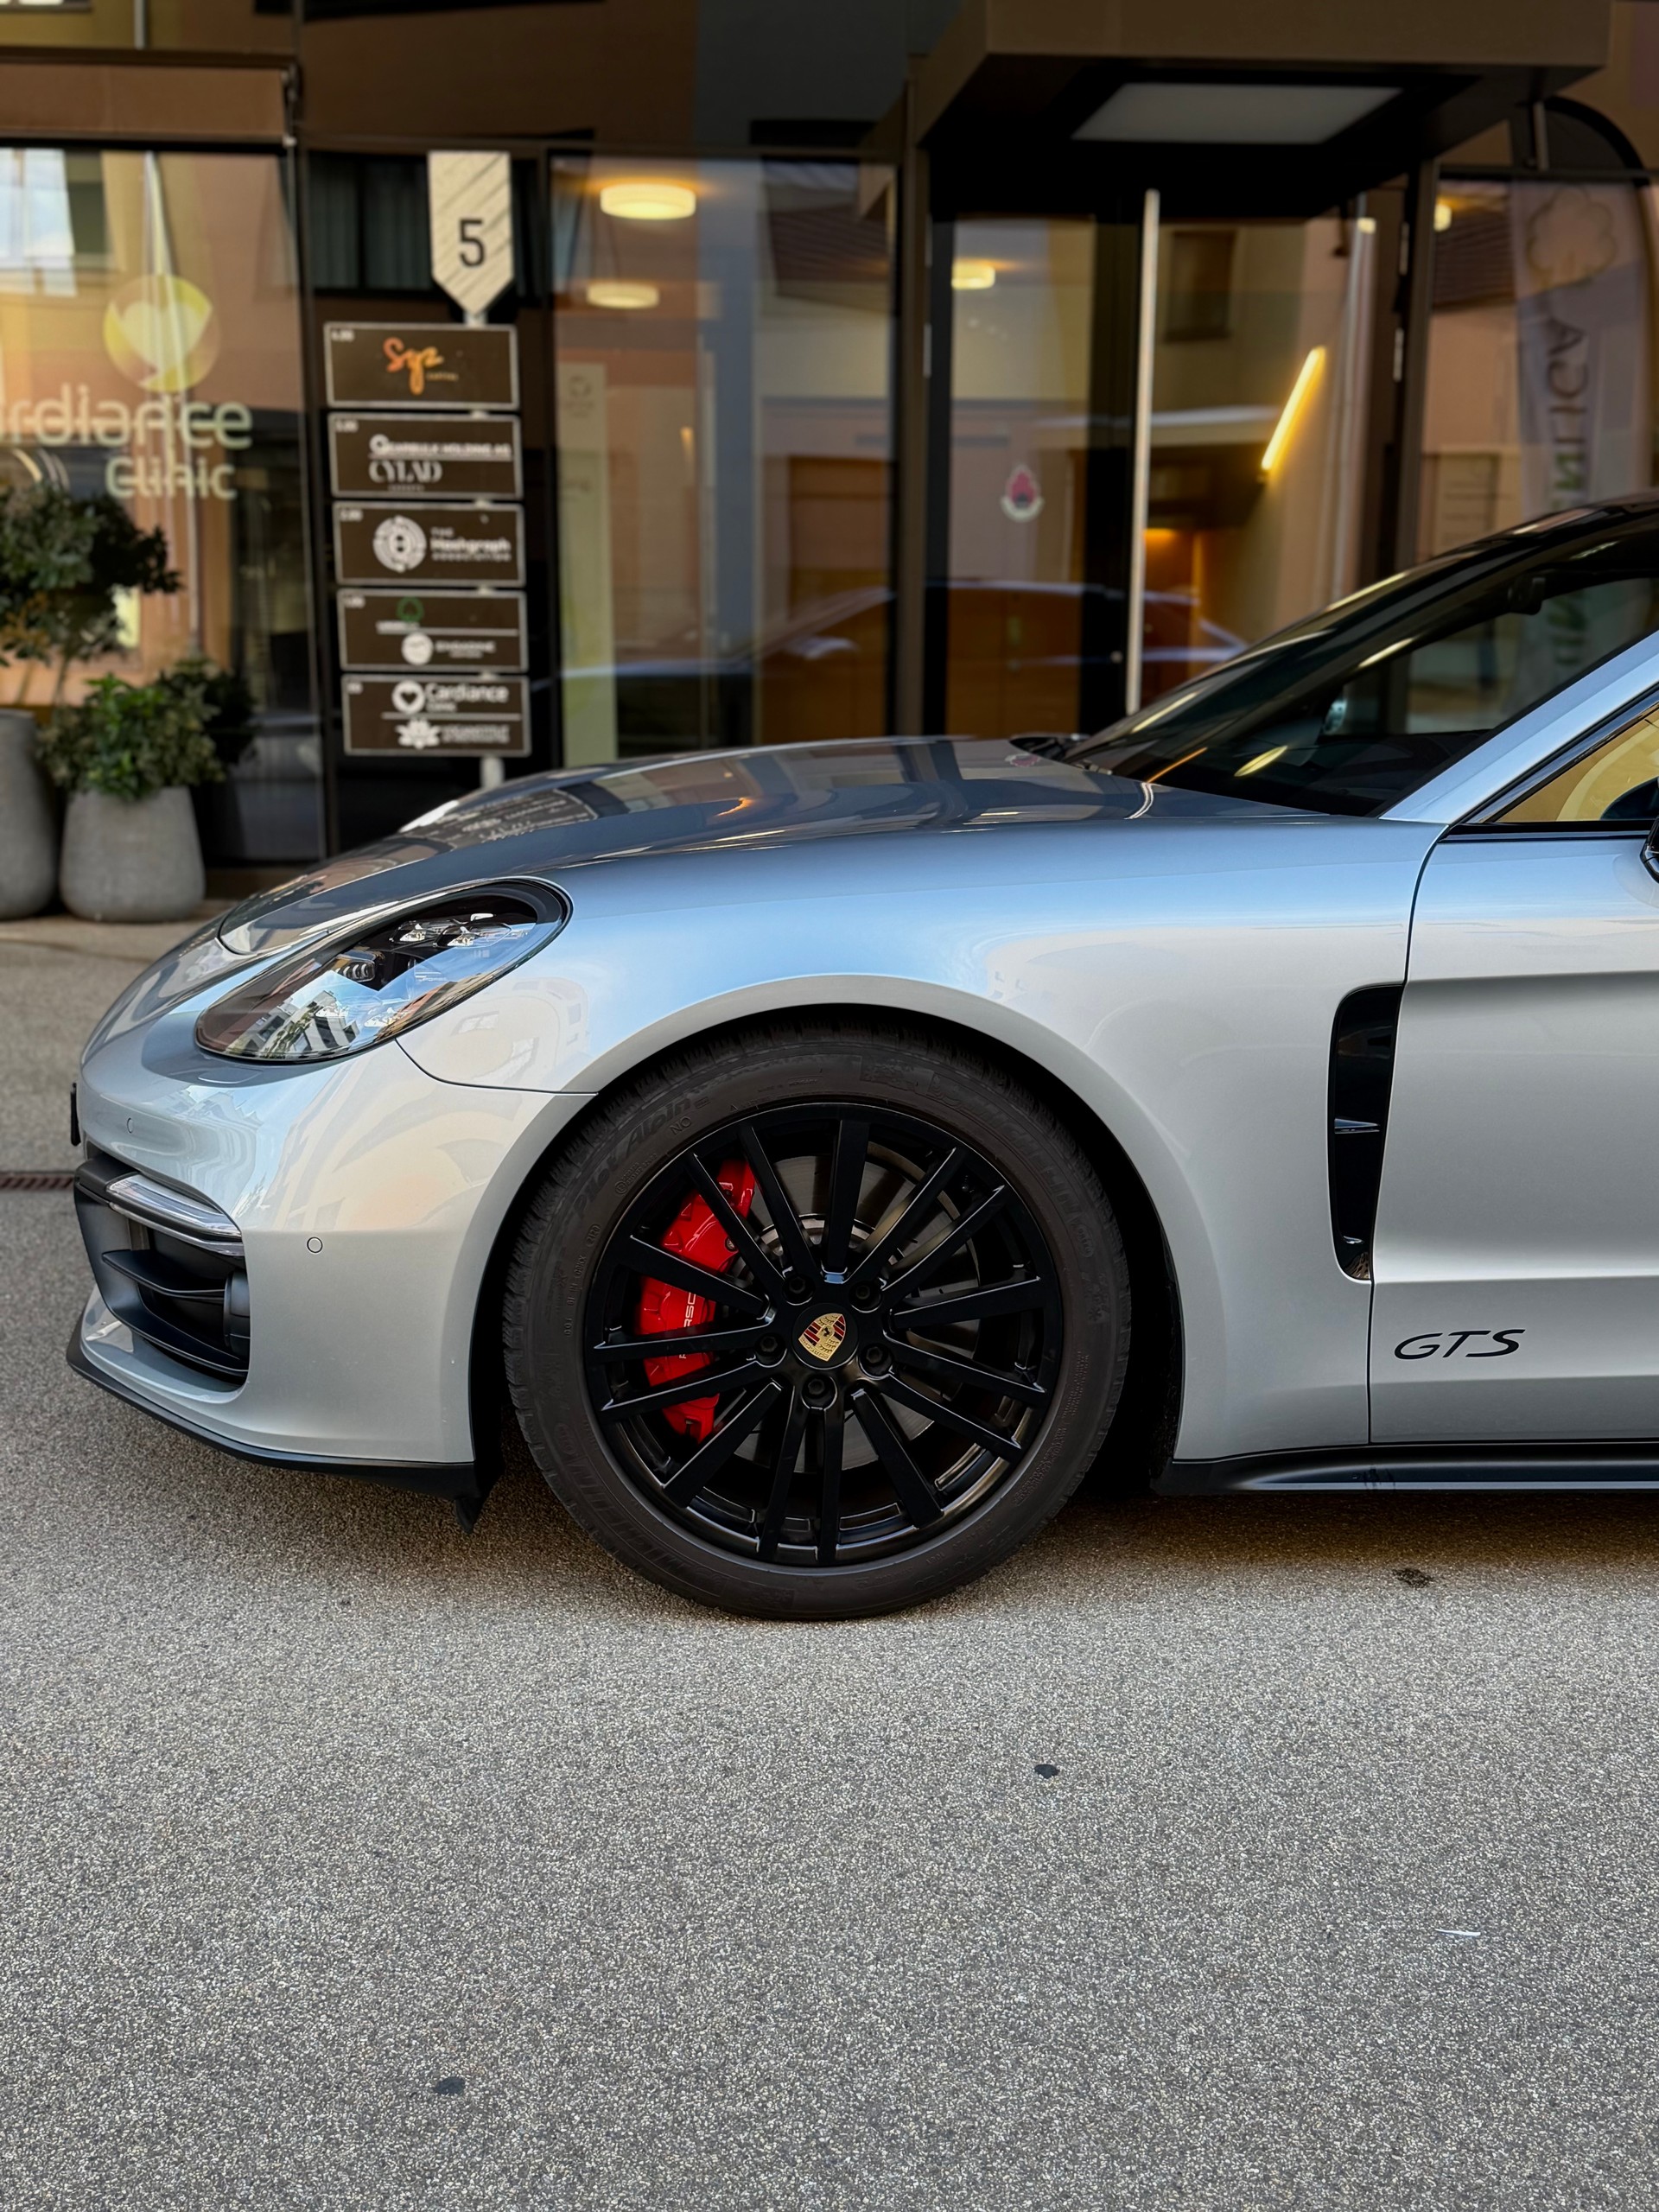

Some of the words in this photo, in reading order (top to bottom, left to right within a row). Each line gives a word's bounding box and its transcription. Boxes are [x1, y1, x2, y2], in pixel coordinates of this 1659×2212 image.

[459, 219, 485, 267] 5
[0, 384, 253, 448] rdiance
[105, 454, 238, 499] Clinic
[425, 682, 509, 703] Cardiance
[1394, 1329, 1526, 1360] GTS
